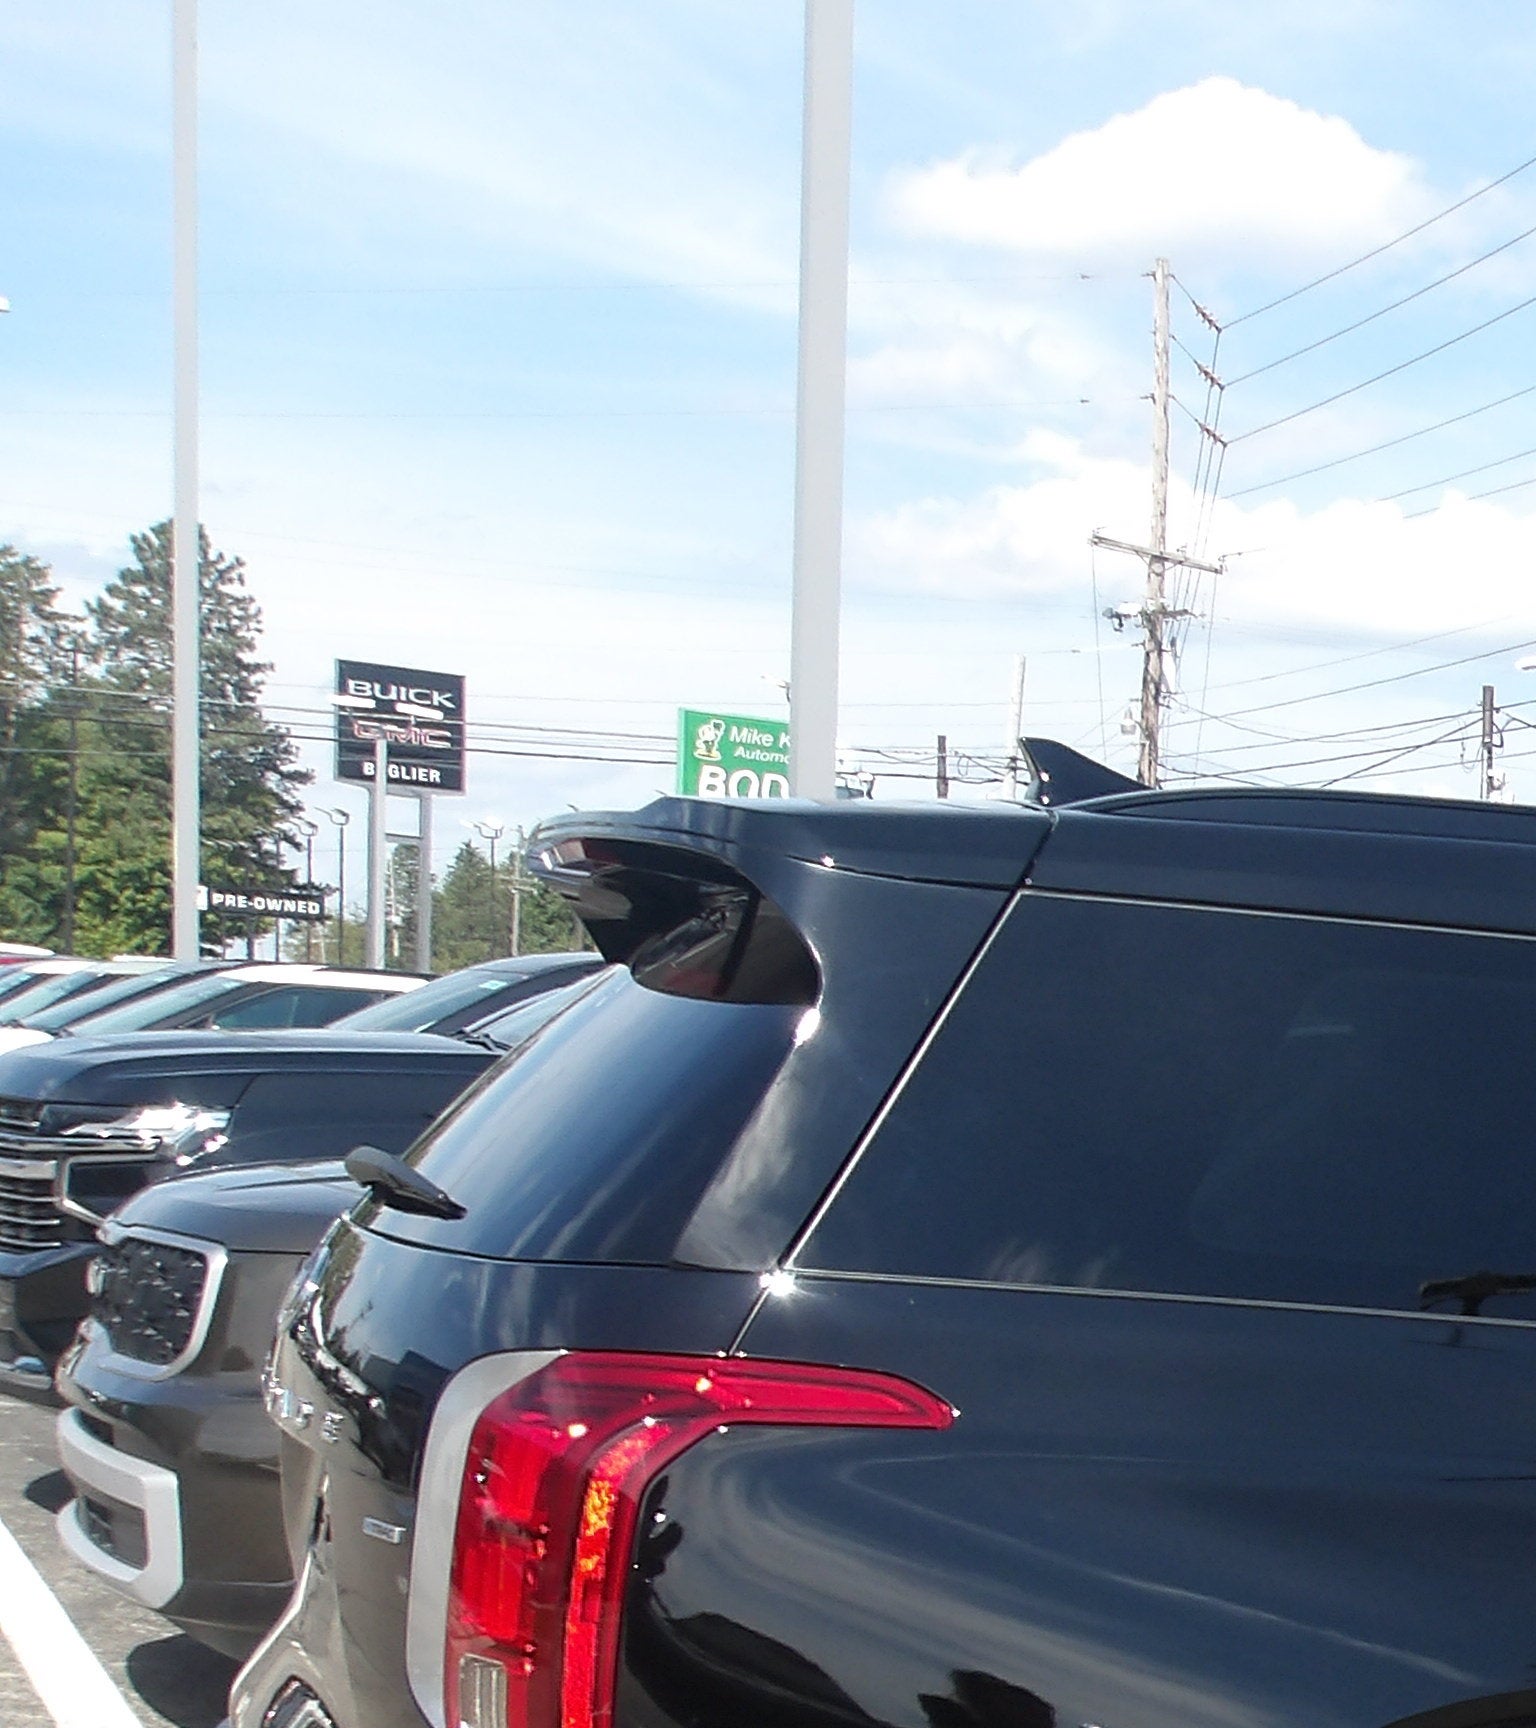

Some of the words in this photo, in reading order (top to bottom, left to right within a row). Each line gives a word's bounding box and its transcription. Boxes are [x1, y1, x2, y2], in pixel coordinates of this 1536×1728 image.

[346, 679, 456, 709] BUICK
[729, 726, 774, 747] Mike
[362, 761, 441, 783] BGLIER
[211, 892, 321, 915] PRE-OWNED
